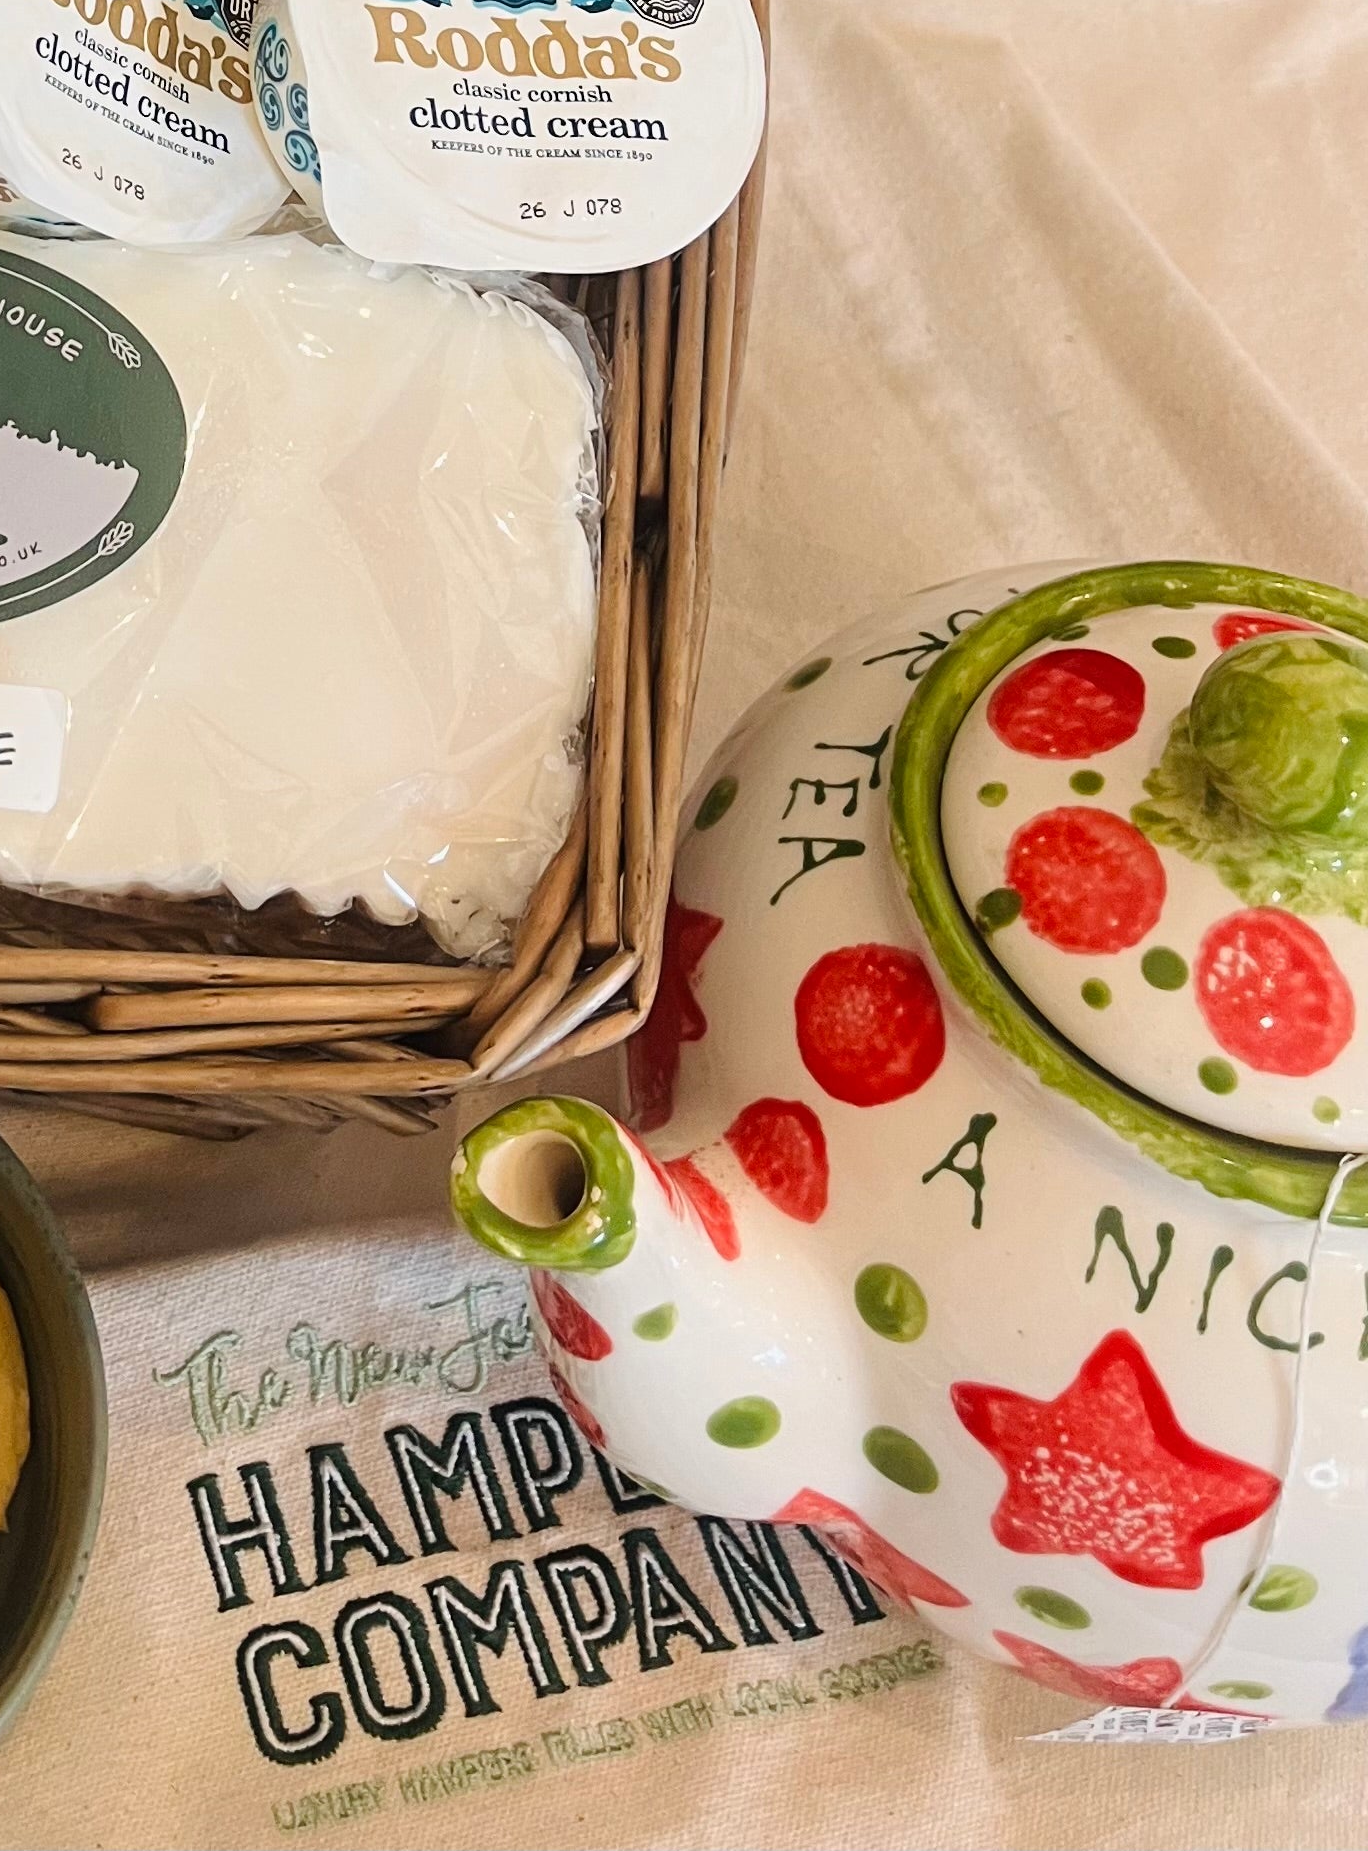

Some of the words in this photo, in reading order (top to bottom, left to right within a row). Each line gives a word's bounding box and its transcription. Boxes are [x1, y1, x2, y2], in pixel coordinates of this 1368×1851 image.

[364, 3, 683, 83] Rodda's
[36, 32, 129, 106] clotted
[138, 95, 231, 155] cream
[409, 98, 536, 138] clotted
[547, 116, 669, 141] cream
[453, 78, 521, 102] classic
[528, 84, 612, 103] cornish
[432, 140, 484, 153] KEEPERS
[487, 145, 502, 155] OF
[506, 147, 532, 158] THE
[536, 149, 581, 159] CREAM
[585, 149, 622, 159] SINCE
[626, 150, 653, 162] 1890
[519, 202, 547, 220] 26
[563, 200, 575, 217] J
[586, 198, 622, 216] 078
[770, 724, 894, 905] TEA
[921, 1111, 999, 1231] A
[1083, 1204, 1368, 1362] NIC
